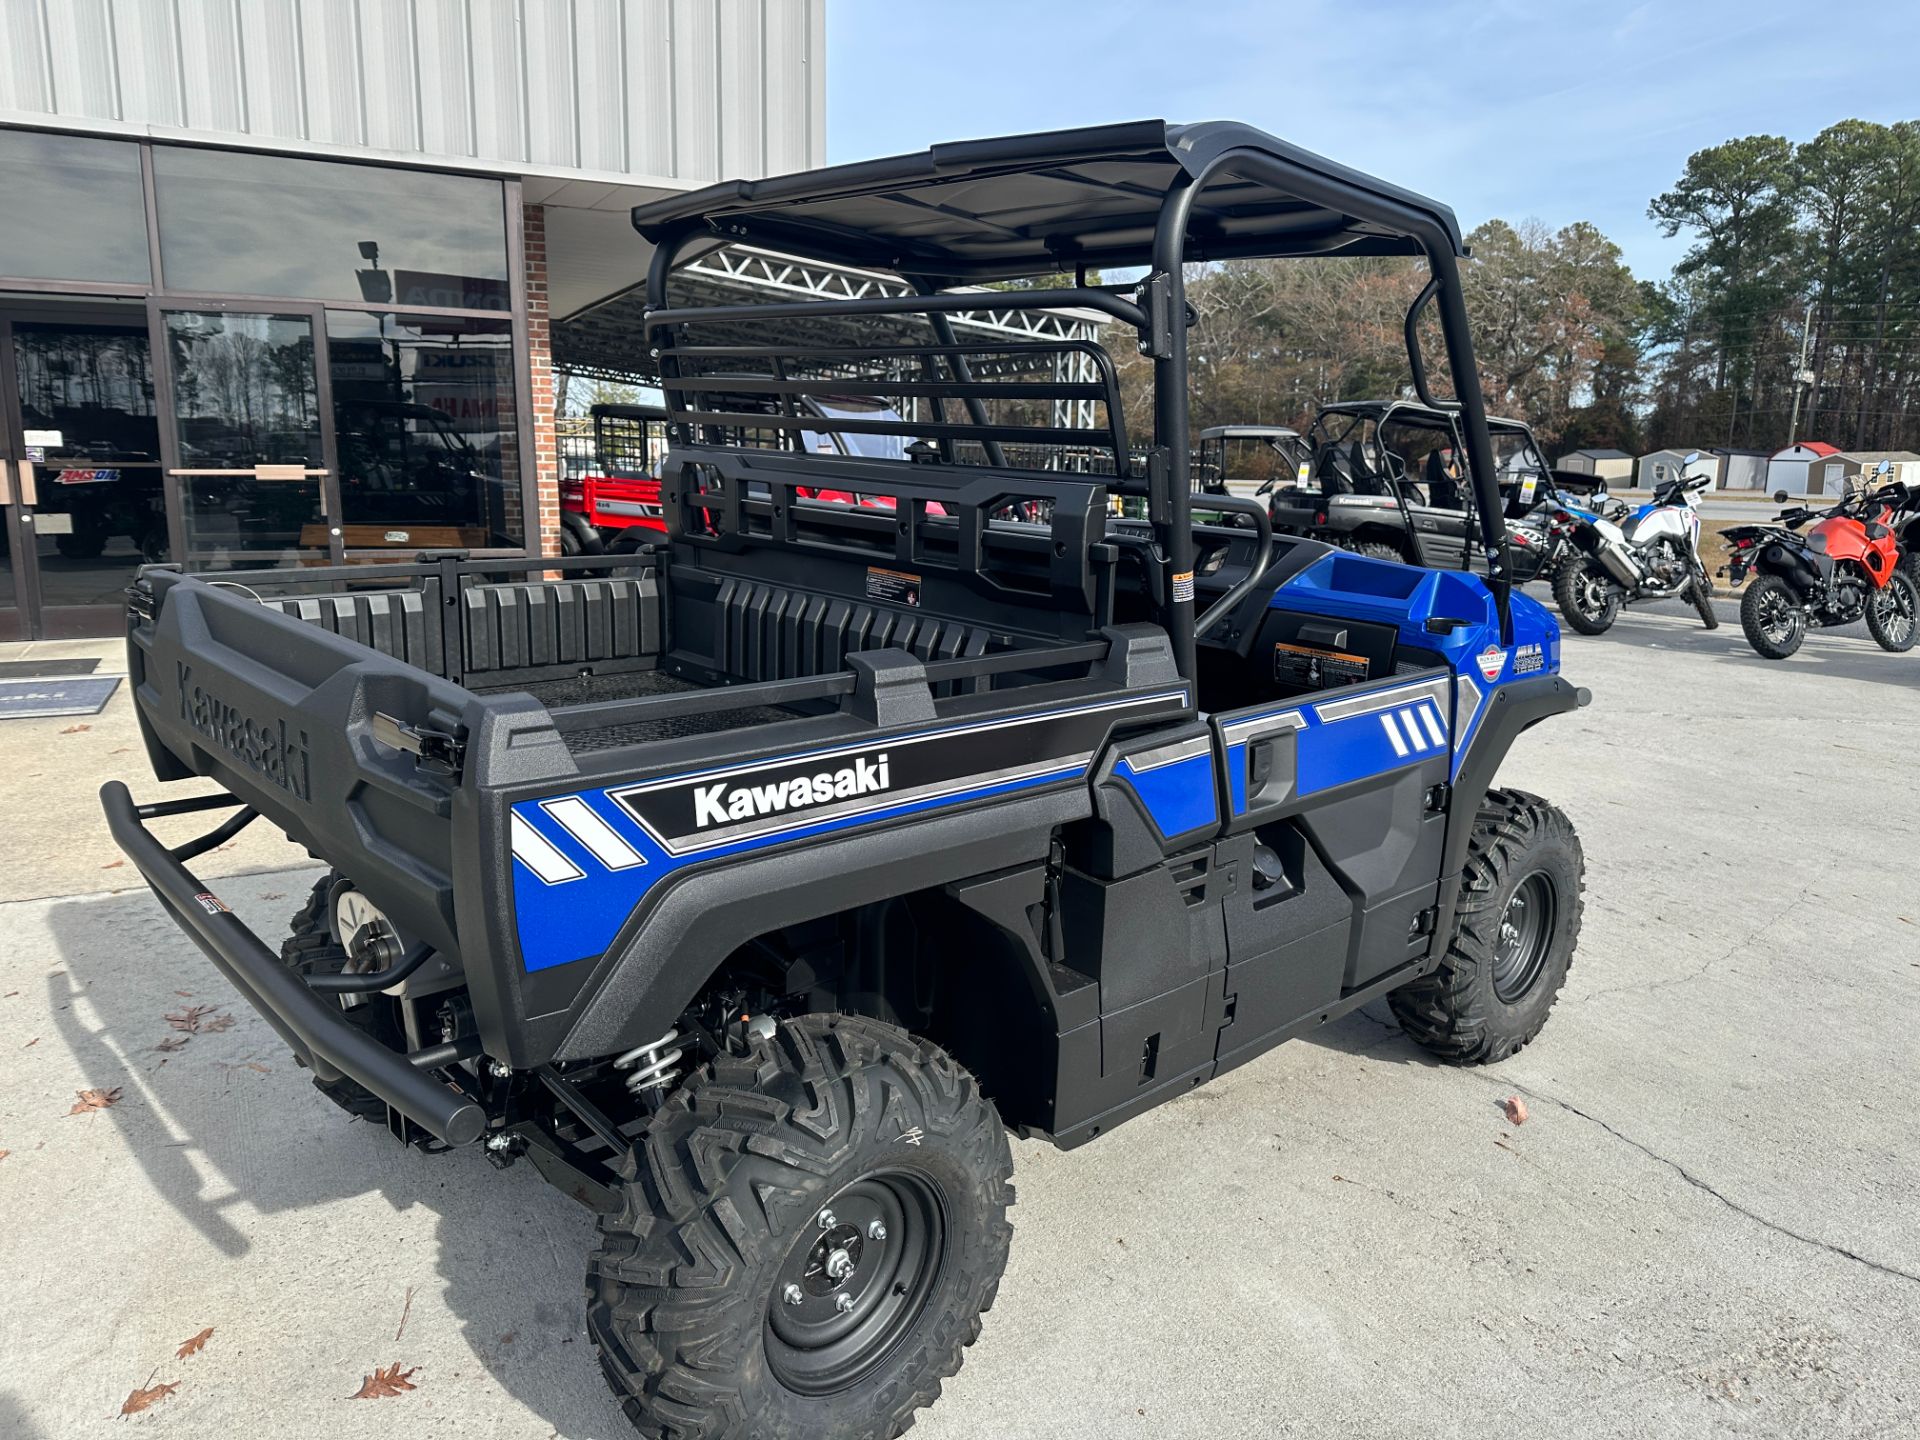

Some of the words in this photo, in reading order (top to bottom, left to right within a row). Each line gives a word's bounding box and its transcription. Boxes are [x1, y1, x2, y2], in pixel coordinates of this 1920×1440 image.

[56, 469, 120, 484] AMSOIL
[1339, 497, 1373, 506] Kawasaki
[177, 660, 312, 804] Kawasaki
[693, 753, 890, 828] Kawasaki
